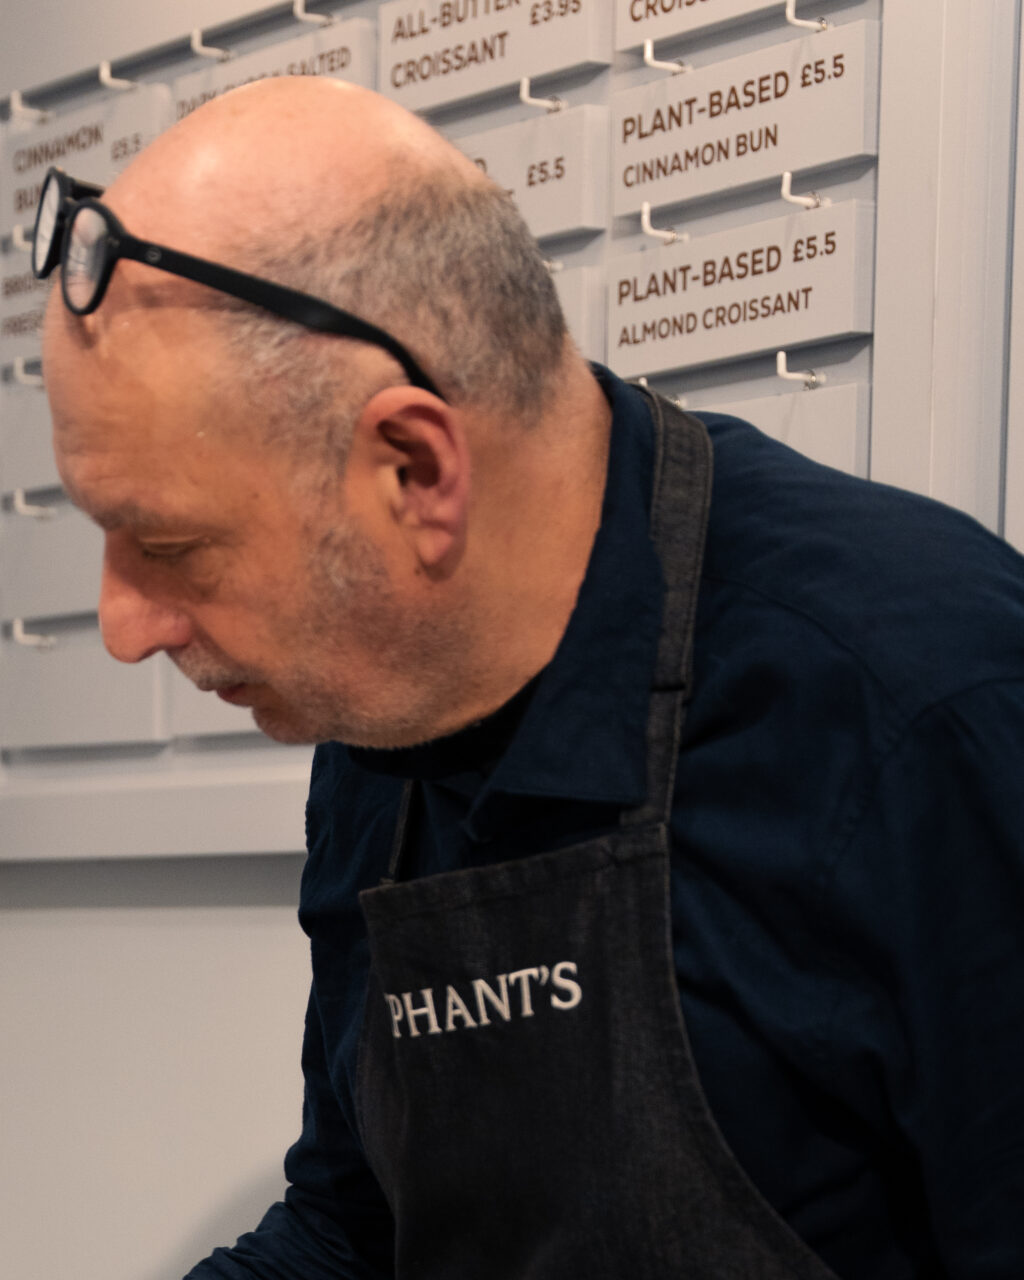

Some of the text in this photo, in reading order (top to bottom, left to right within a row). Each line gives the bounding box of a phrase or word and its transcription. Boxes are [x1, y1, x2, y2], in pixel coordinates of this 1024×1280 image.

[391, 32, 509, 88] CROISSANT
[622, 54, 845, 144] PLANT-BASED £5.5
[12, 124, 104, 172] CINNAMON
[527, 158, 565, 187] £5.5
[623, 124, 779, 188] CINNAMON BUN
[618, 232, 837, 305] PLANT-BASED £5.5
[619, 287, 813, 347] ALMOND CROISSANT
